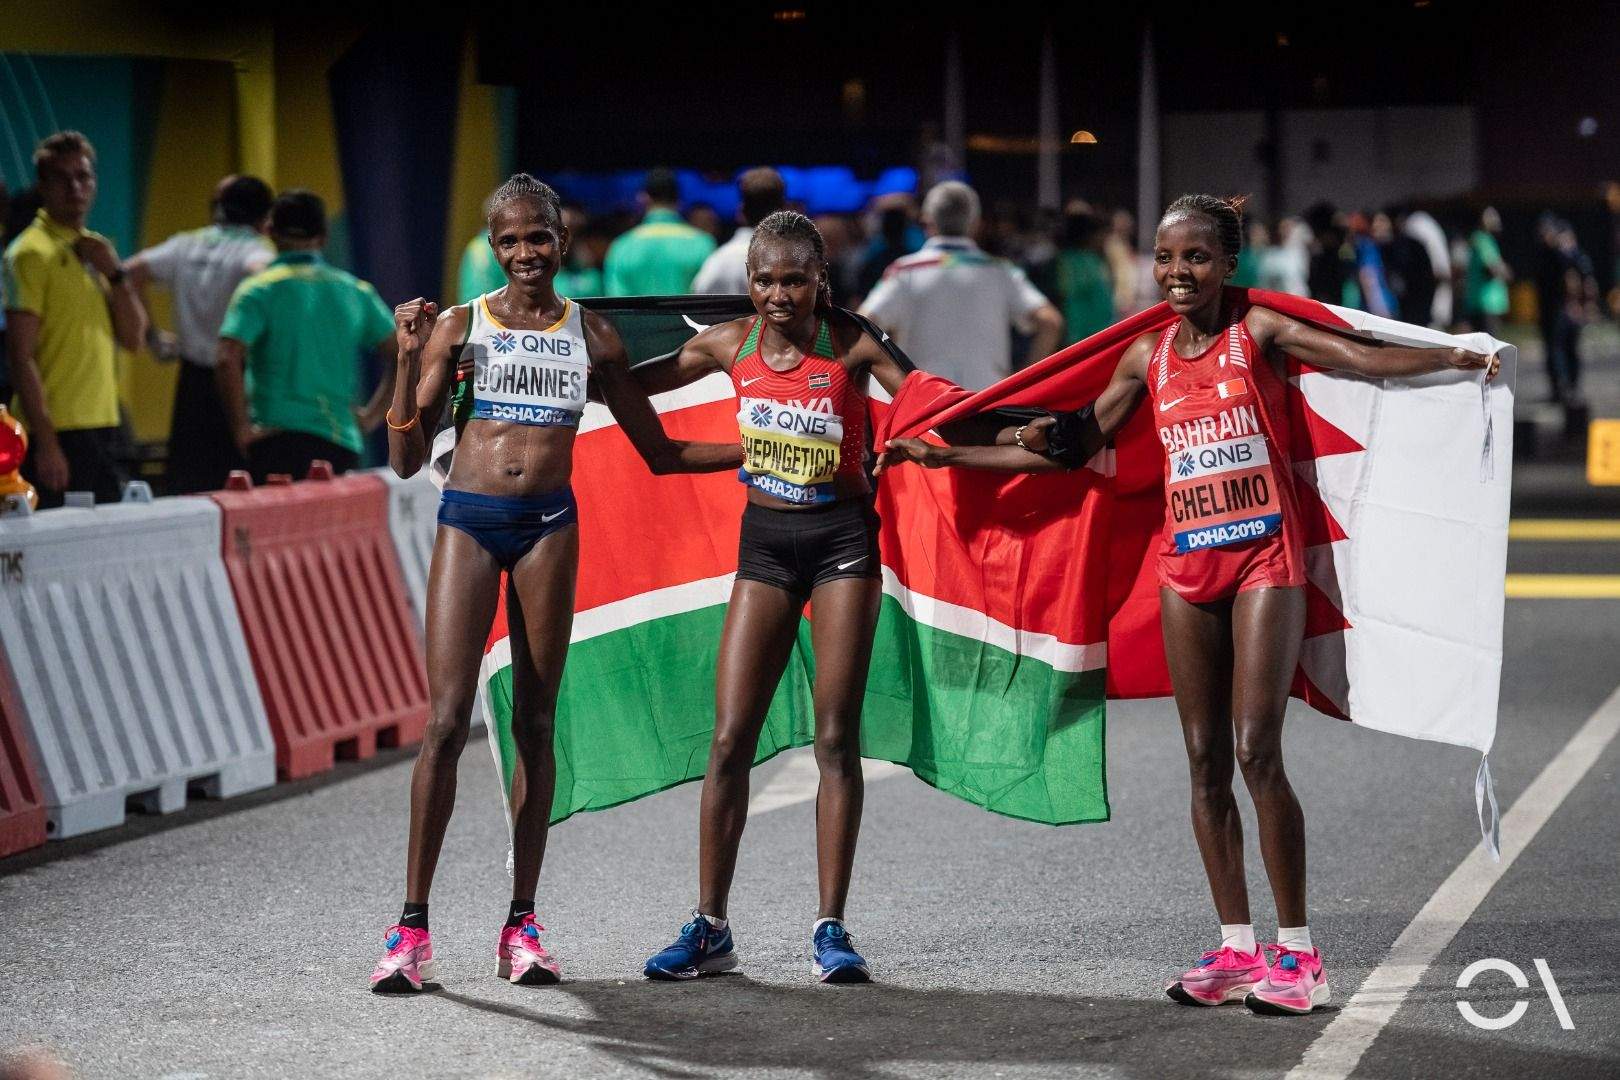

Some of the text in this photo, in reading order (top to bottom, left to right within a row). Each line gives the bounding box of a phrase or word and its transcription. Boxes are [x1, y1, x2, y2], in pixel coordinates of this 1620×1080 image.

[521, 334, 572, 357] QNB
[476, 362, 582, 402] JOHANNES
[777, 411, 827, 435] QNB
[1159, 404, 1260, 453] BAHRAIN
[742, 433, 836, 478] HEPNGETICH
[1199, 443, 1253, 469] QNB
[752, 474, 818, 501] DOHA2019
[1171, 473, 1270, 523] CHELIMO
[1187, 520, 1266, 549] DOHA2019
